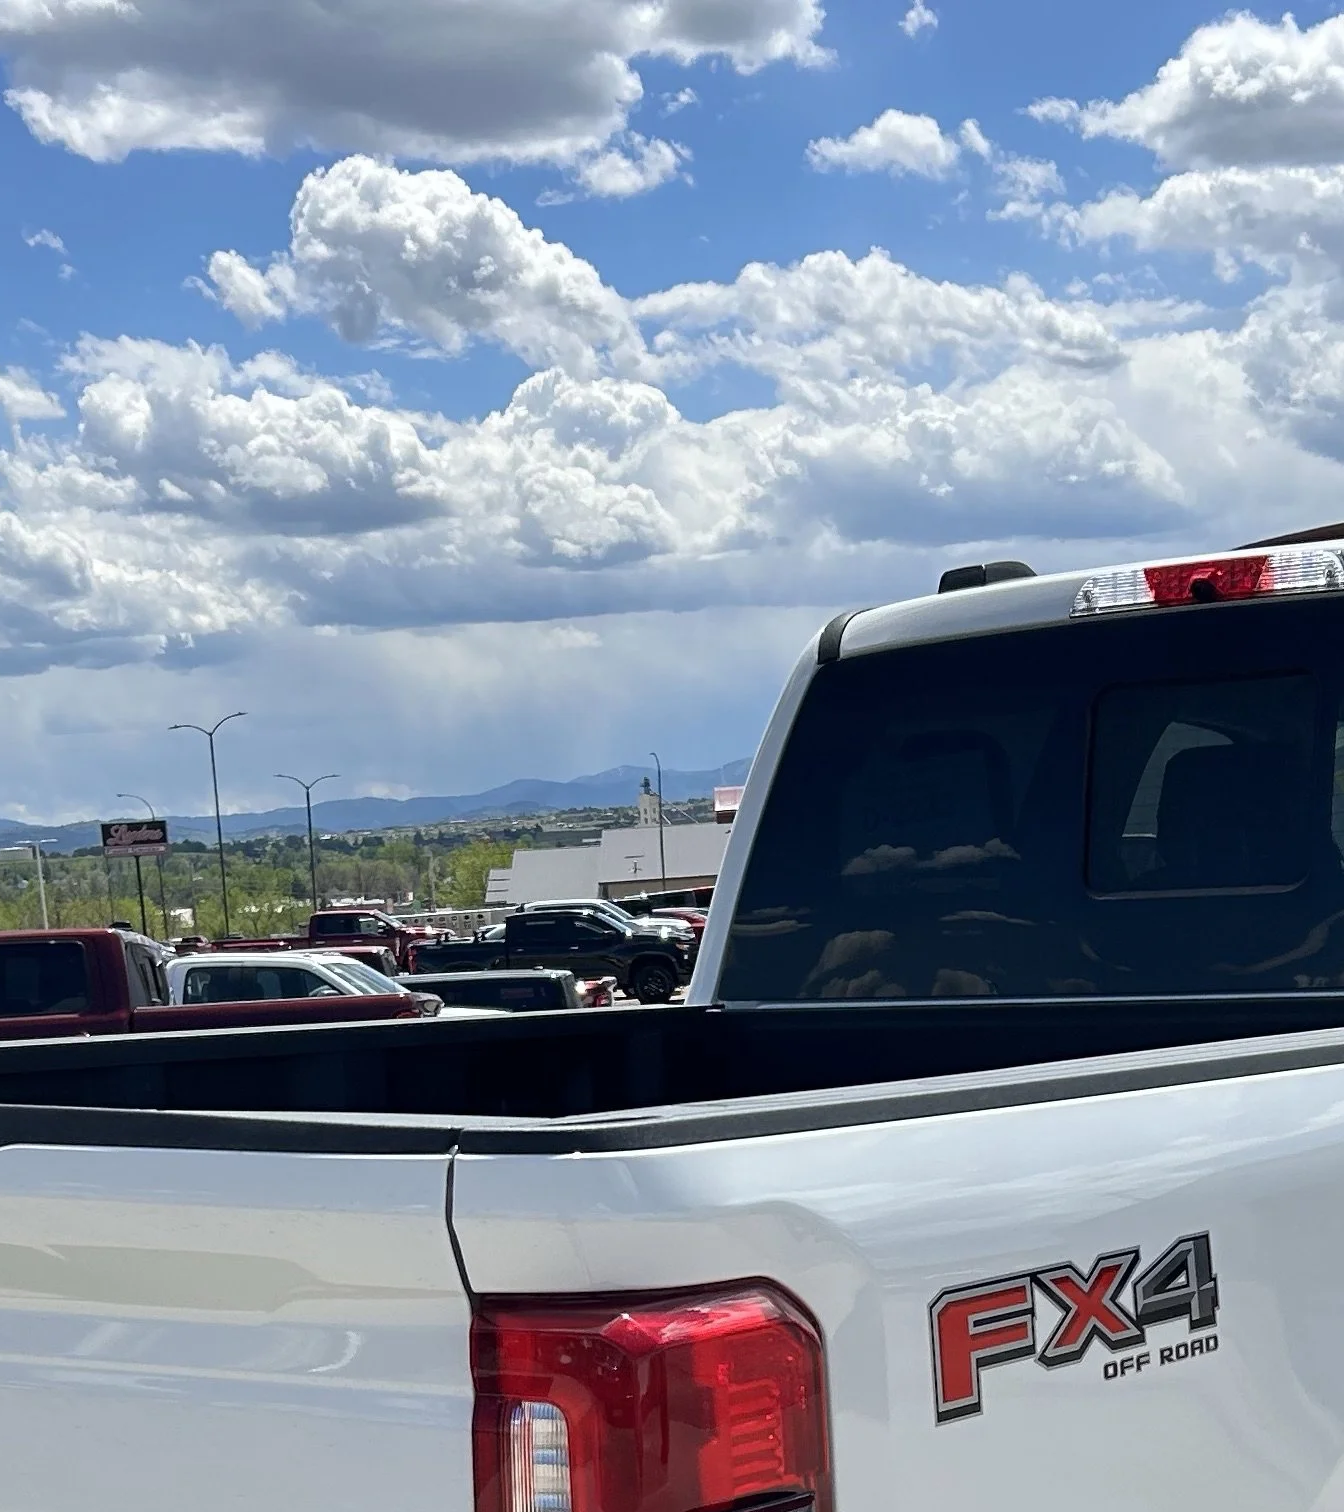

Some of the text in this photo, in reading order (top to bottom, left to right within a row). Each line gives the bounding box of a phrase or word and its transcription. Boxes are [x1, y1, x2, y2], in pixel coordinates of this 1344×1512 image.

[926, 1229, 1220, 1427] FX4
[1102, 1333, 1219, 1382] OFF ROAD
